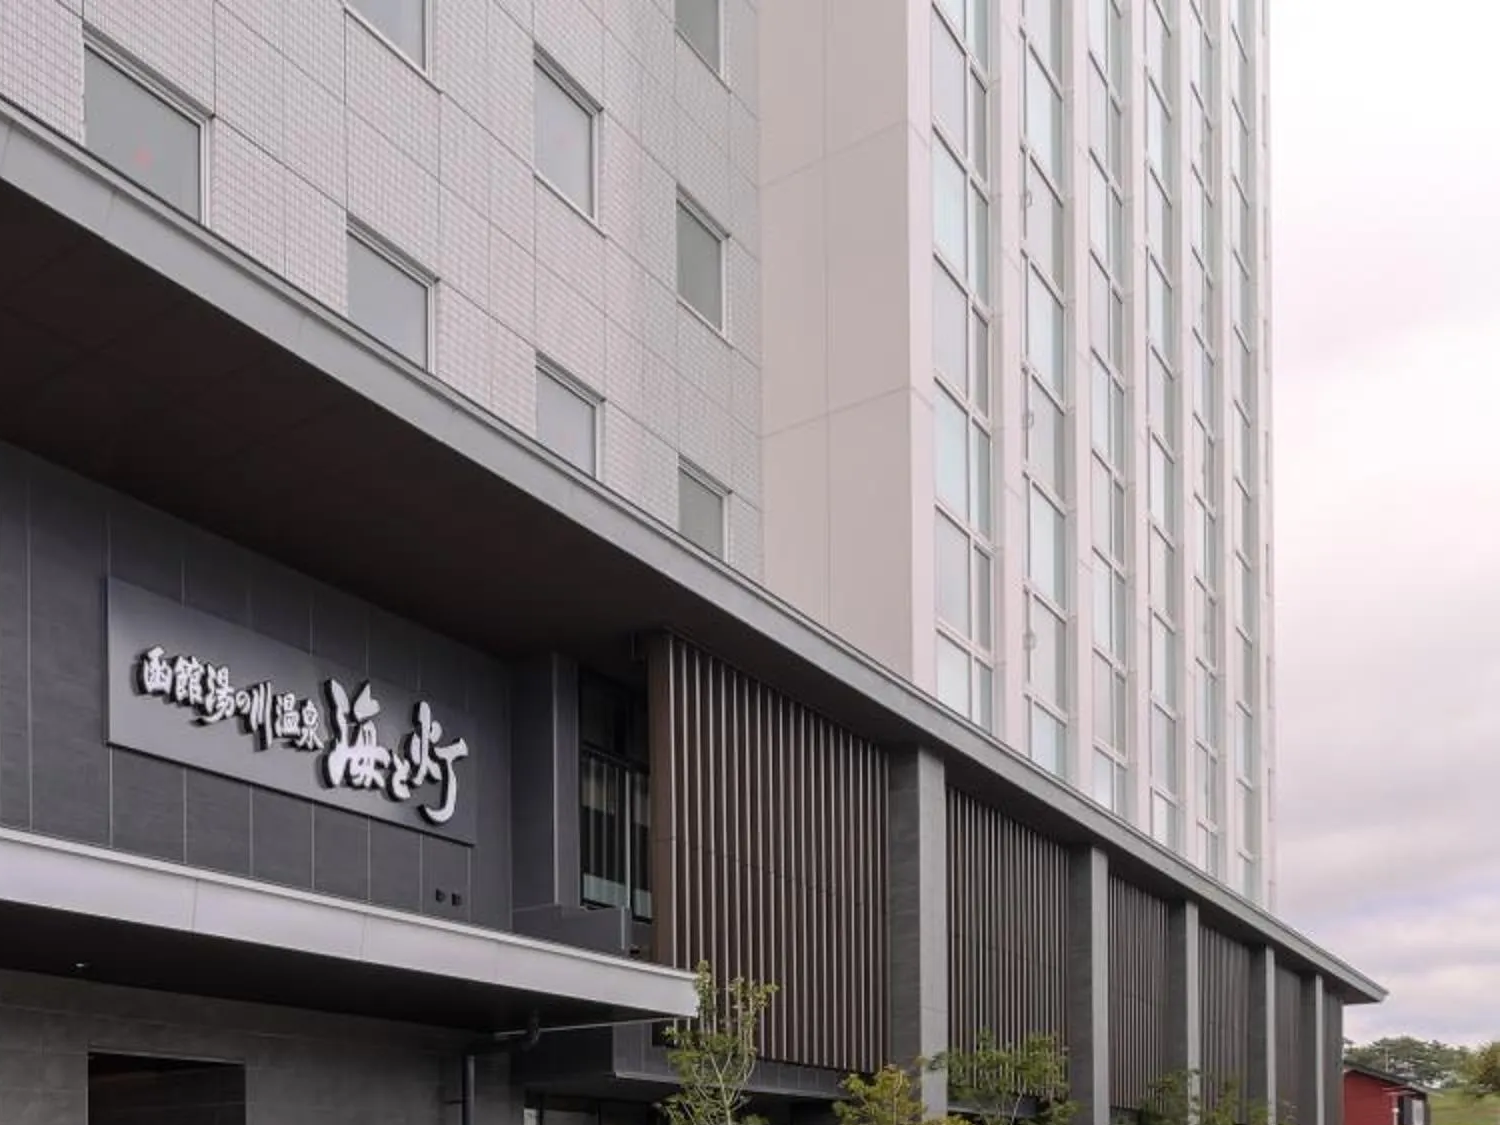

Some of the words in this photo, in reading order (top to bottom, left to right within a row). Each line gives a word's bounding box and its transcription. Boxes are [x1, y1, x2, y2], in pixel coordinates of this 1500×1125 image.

[142, 646, 326, 750] 函館湯の川温泉
[327, 679, 469, 823] 海と灯
